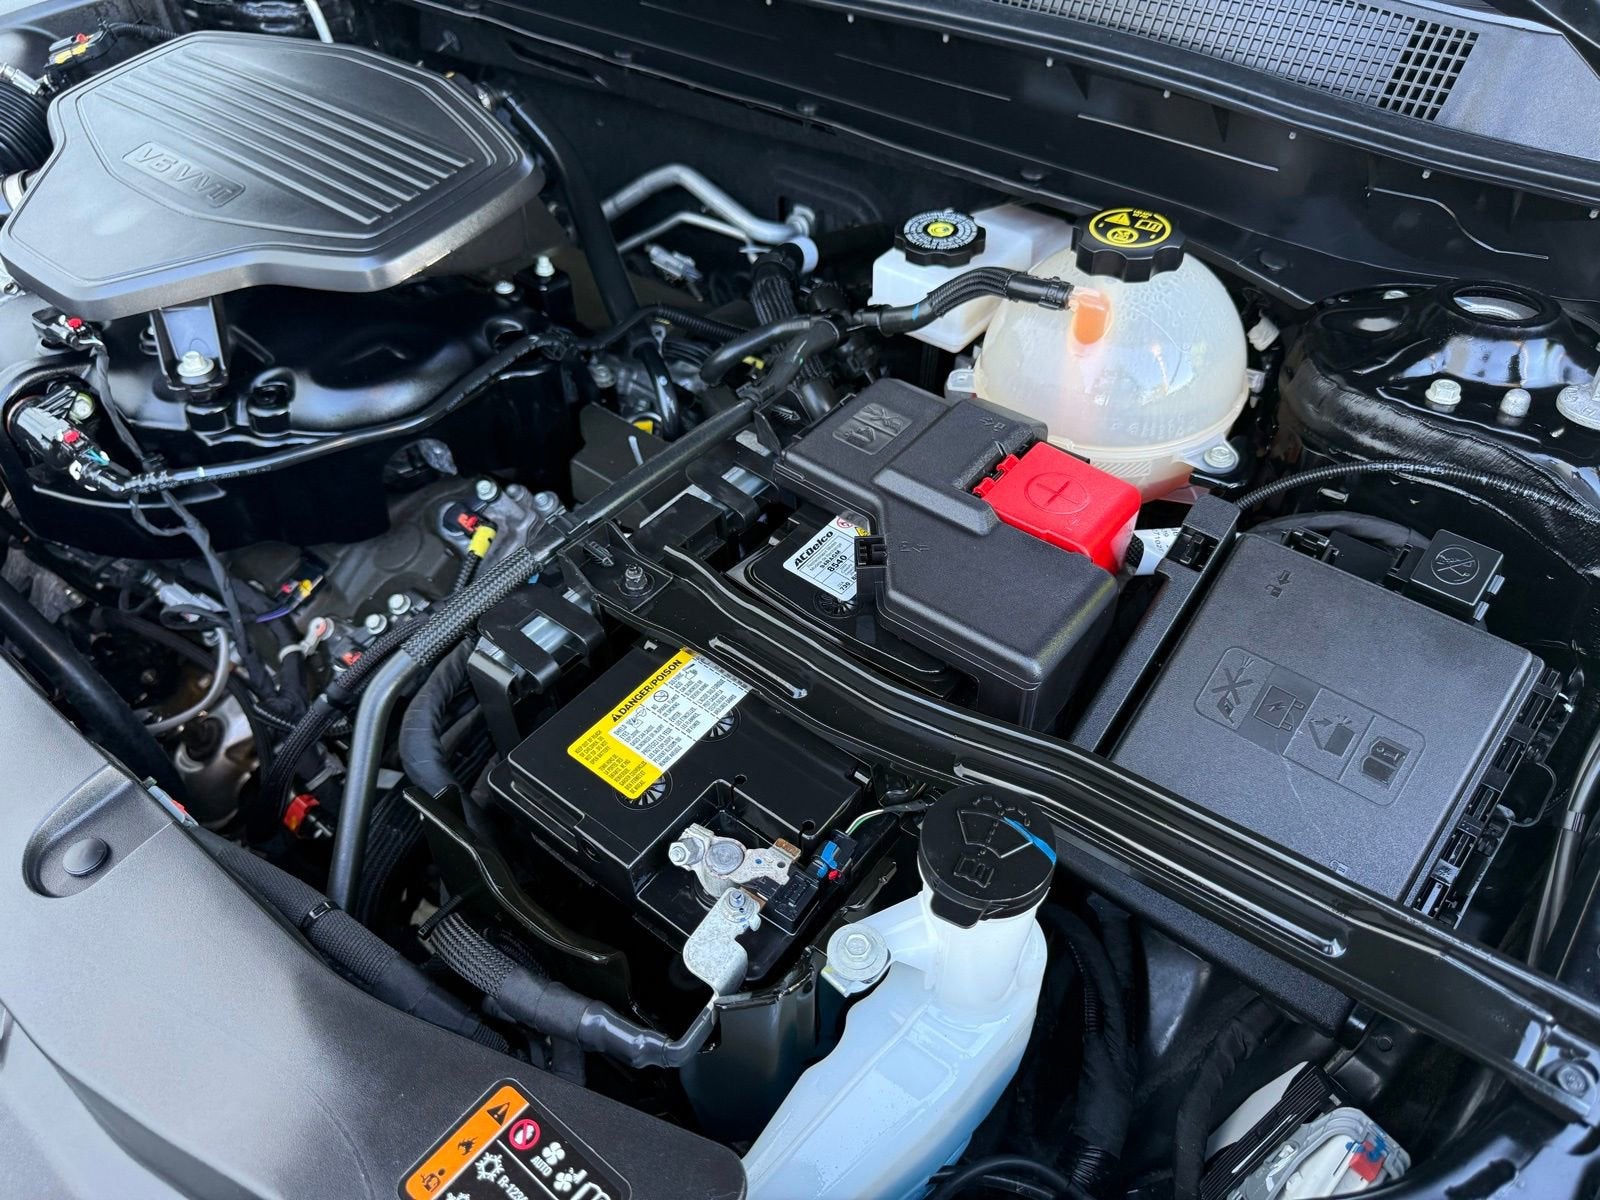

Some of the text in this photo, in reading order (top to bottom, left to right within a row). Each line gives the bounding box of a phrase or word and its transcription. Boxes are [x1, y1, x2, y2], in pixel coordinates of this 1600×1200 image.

[136, 147, 179, 173] V6
[794, 531, 834, 567] ACDelco
[826, 554, 848, 572] 8540
[618, 658, 682, 716] DANGER/POISON
[530, 1155, 552, 1177] AUTO
